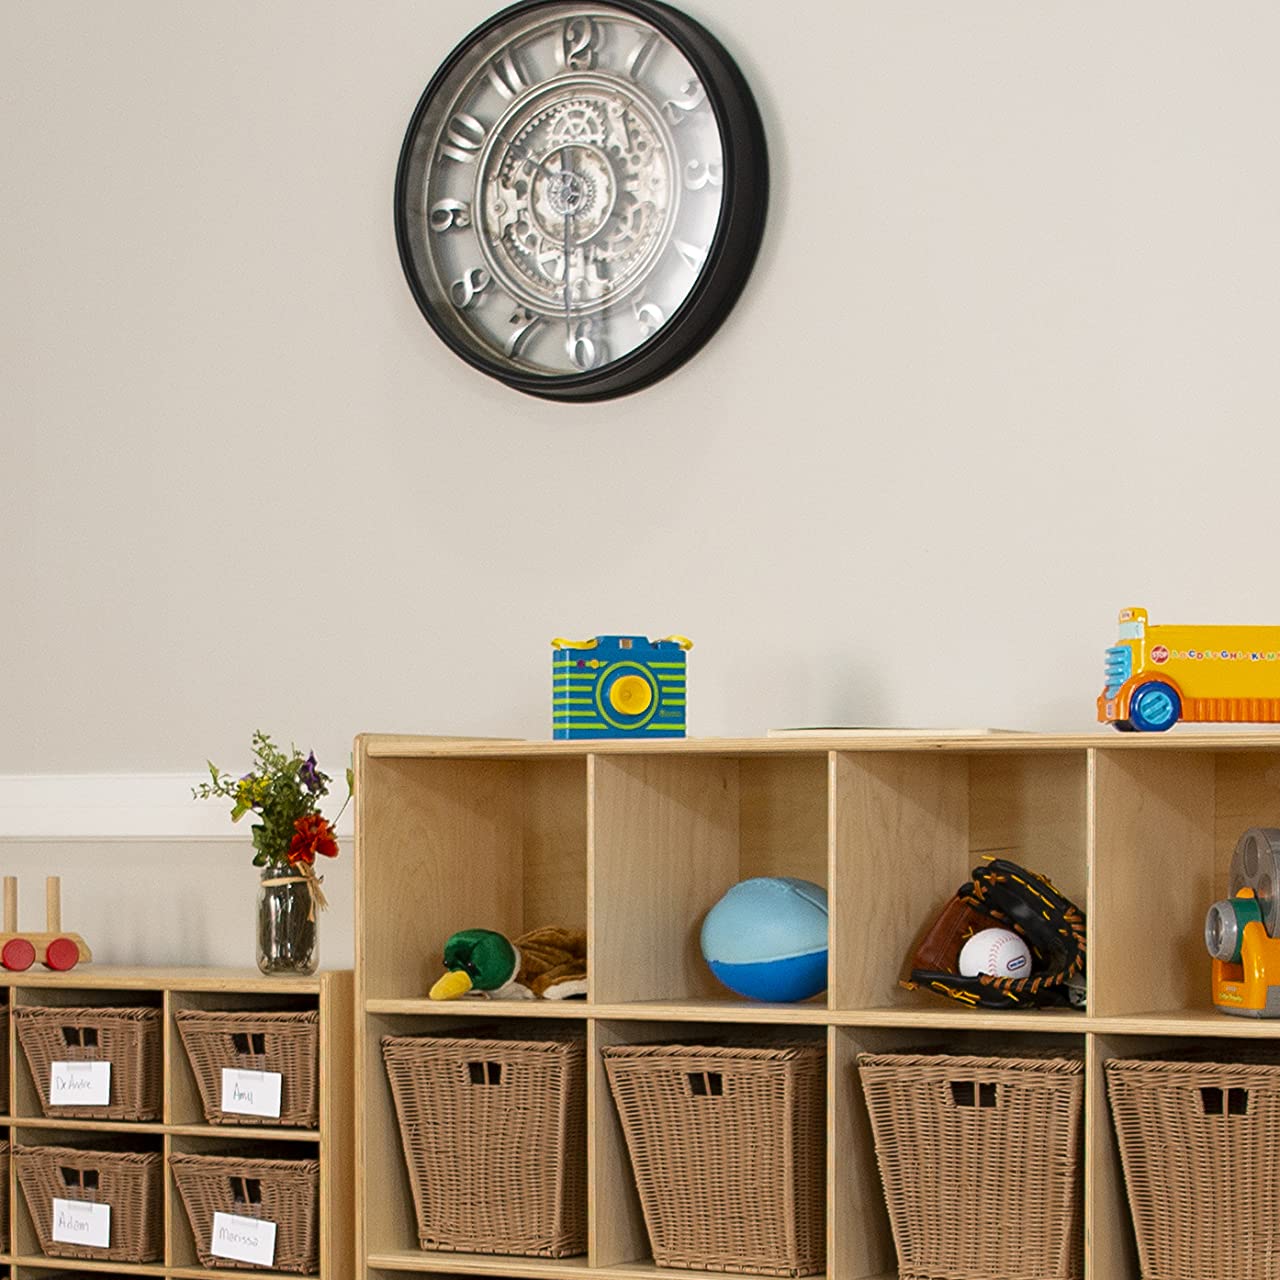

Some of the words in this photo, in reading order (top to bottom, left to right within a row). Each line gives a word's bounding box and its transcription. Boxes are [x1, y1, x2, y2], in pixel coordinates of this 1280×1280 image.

[488, 51, 526, 99] 11
[663, 80, 707, 125] 2
[438, 114, 487, 163] 10
[684, 159, 721, 190] 3
[431, 197, 471, 233] 9
[673, 239, 709, 275] 4
[450, 268, 491, 309] 8
[504, 309, 541, 358] 7
[632, 302, 665, 333] 5
[567, 320, 597, 372] 6
[232, 1082, 254, 1104] Amy
[57, 1211, 90, 1233] Adam
